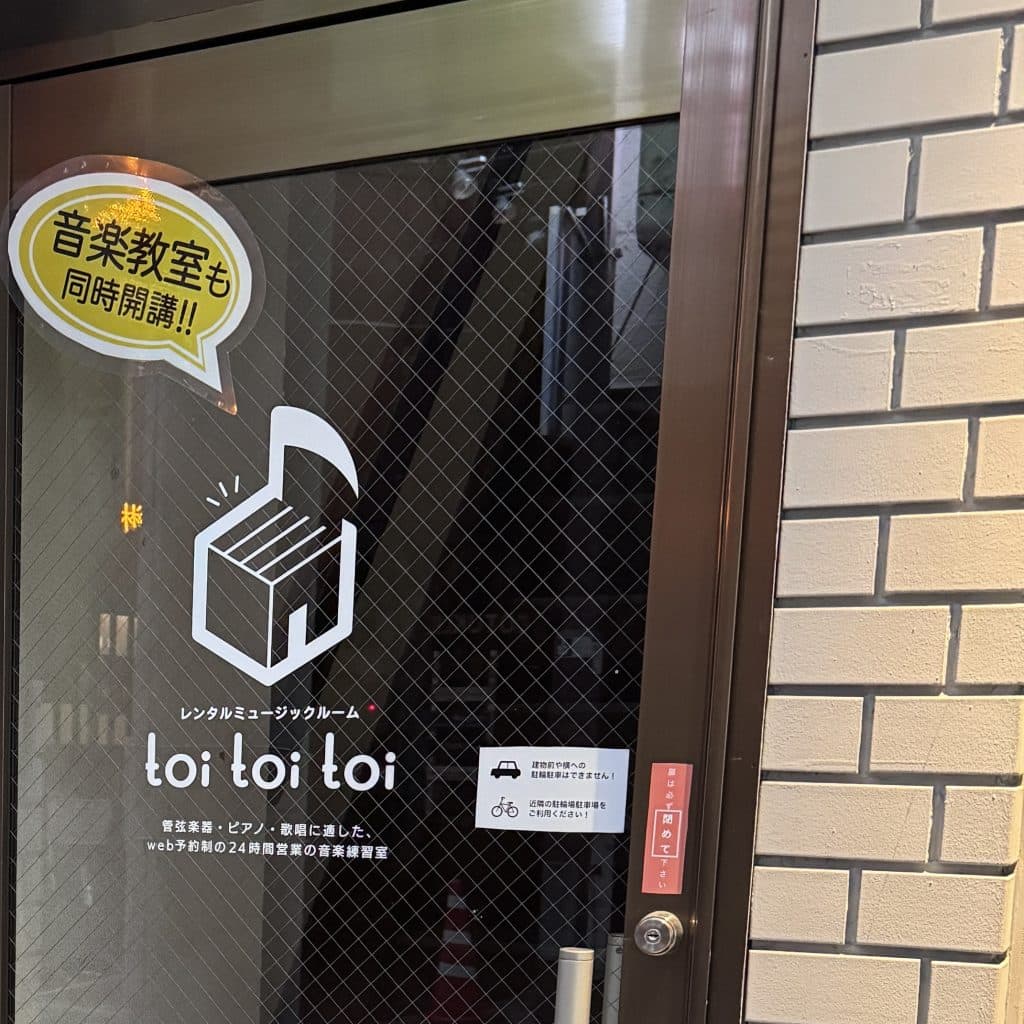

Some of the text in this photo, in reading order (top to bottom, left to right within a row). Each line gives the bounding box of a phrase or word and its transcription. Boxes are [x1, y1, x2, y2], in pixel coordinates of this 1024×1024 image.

[53, 209, 231, 299] 音楽教室も
[62, 268, 197, 335] 同時開講!!
[180, 706, 360, 721] レンタルミュージックルーム
[145, 732, 397, 792] toi toi toi
